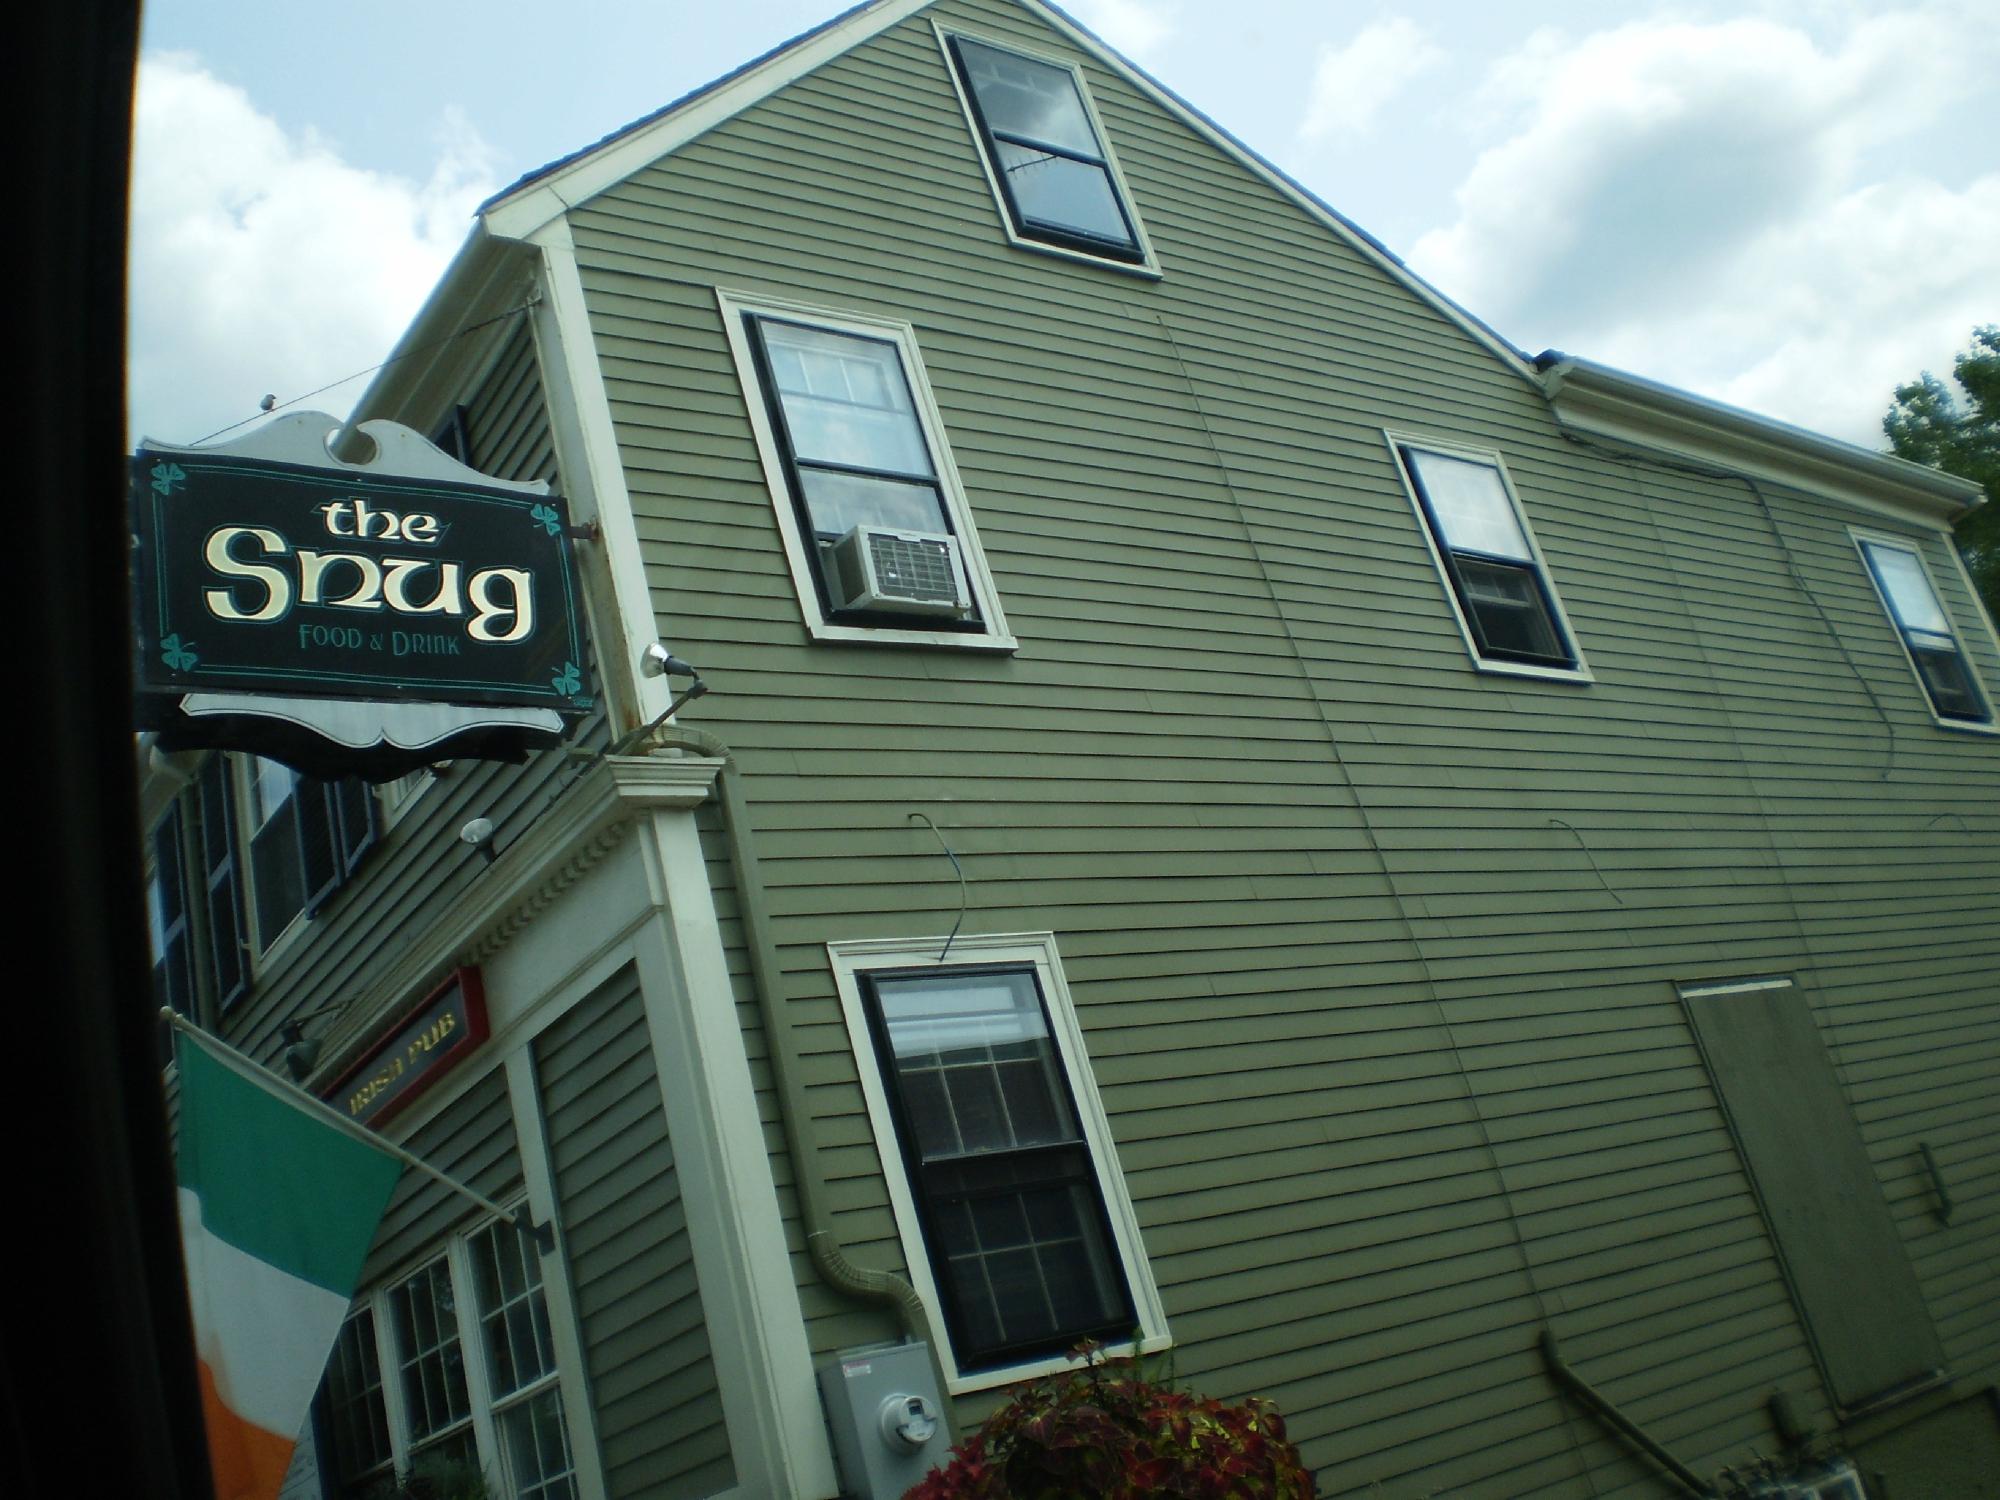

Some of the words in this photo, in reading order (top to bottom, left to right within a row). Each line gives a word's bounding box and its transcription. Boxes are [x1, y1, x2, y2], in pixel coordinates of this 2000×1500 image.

[318, 498, 441, 543] the
[204, 525, 534, 643] Snug
[298, 623, 362, 650] FOOD
[369, 632, 384, 651] &
[408, 1013, 455, 1064] PUB
